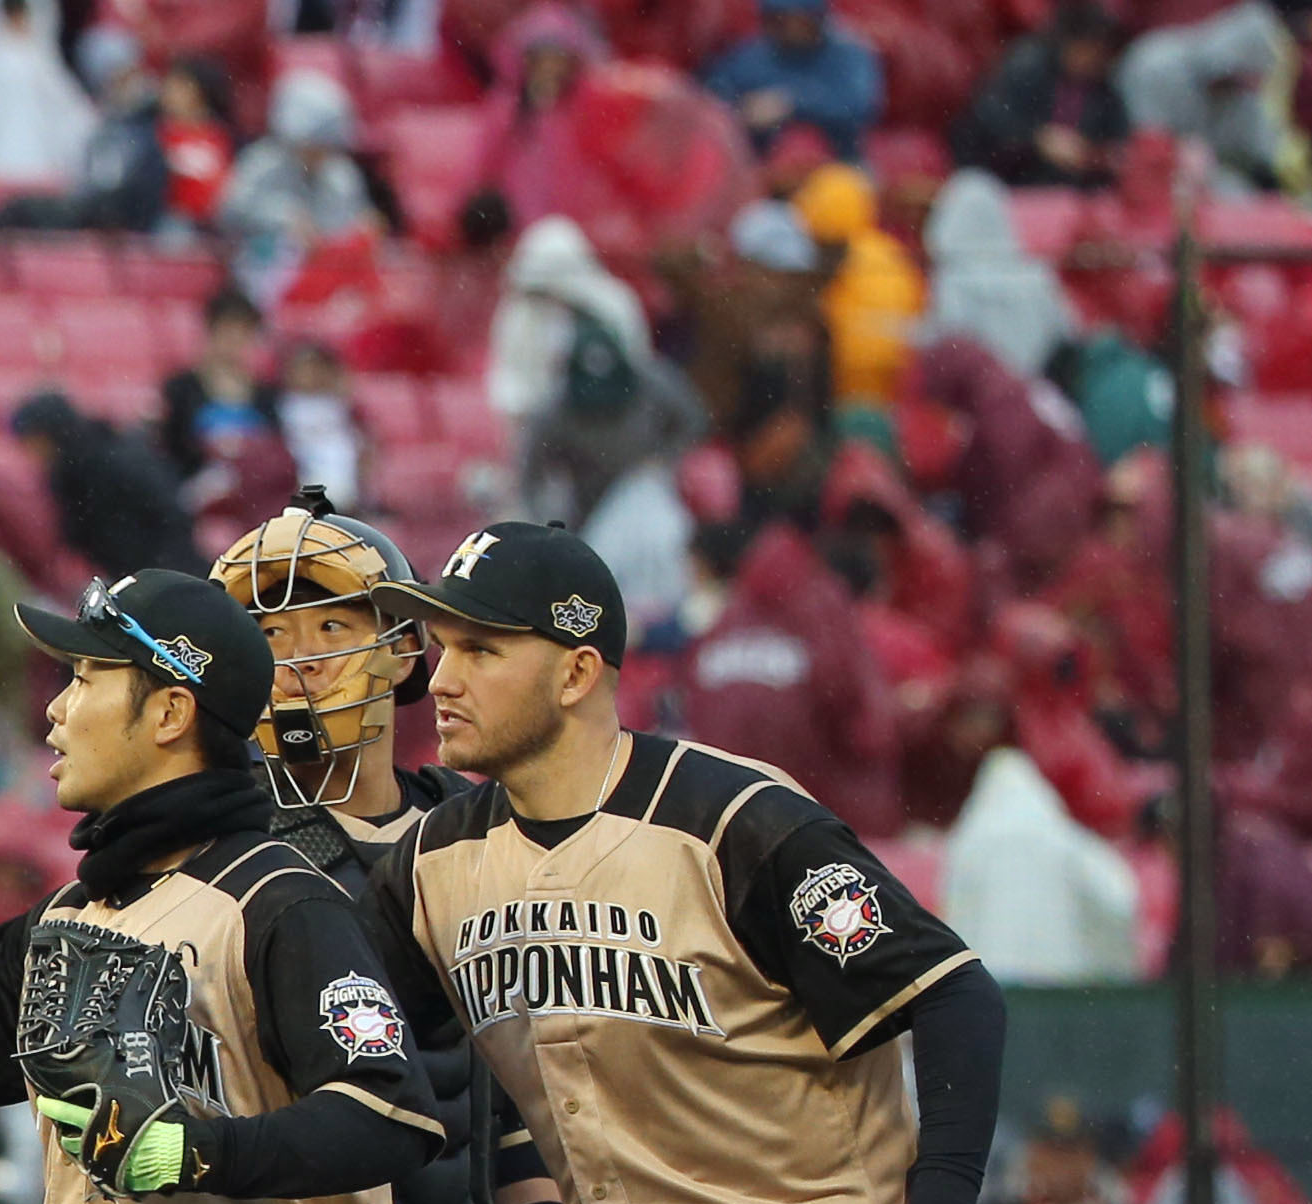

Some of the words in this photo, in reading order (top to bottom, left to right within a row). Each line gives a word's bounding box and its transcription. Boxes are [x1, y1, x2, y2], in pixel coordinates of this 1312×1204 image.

[441, 531, 501, 580] H
[794, 868, 860, 924] FIGHTERS
[454, 899, 663, 961] HOKKAIDO
